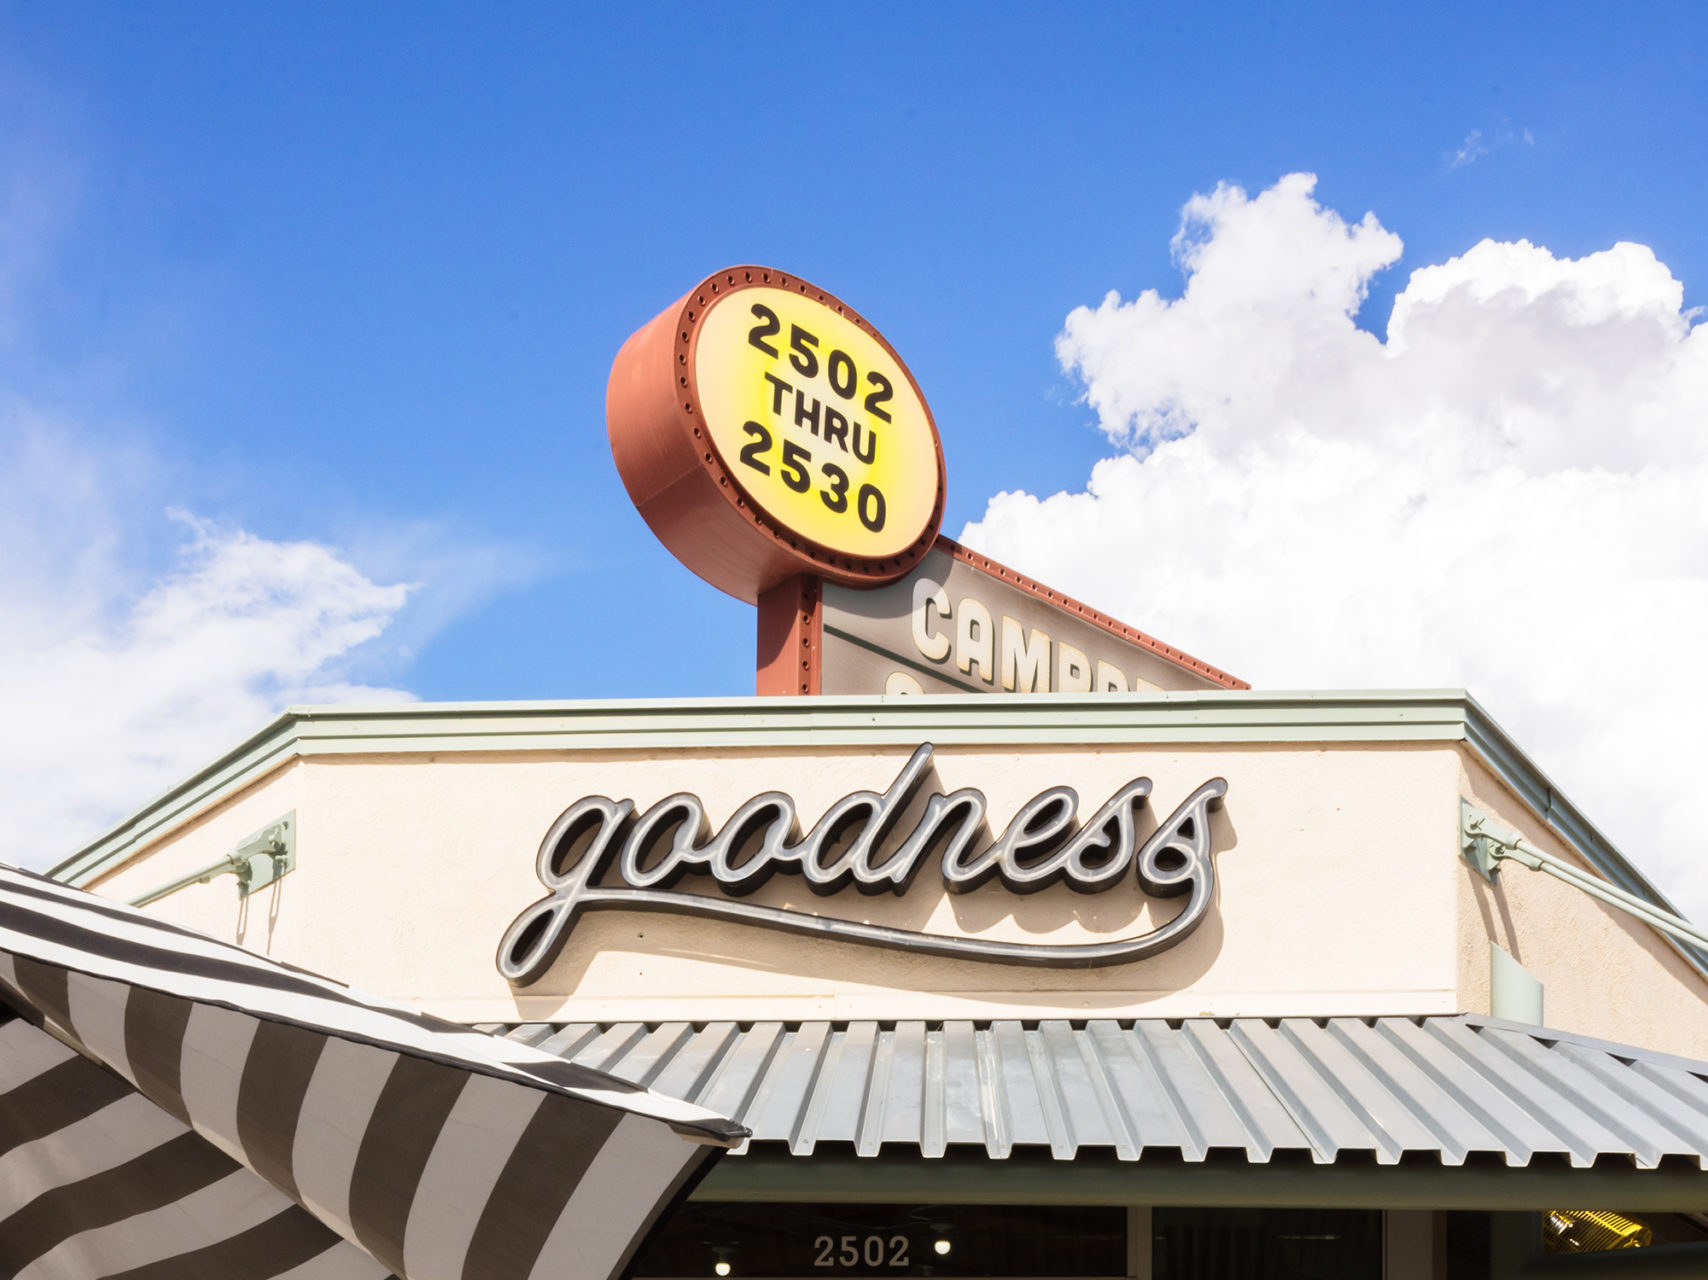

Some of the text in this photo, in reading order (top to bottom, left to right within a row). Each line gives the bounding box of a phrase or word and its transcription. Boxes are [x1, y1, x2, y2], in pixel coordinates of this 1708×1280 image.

[748, 303, 893, 424] 2502
[764, 372, 876, 465] THRU
[740, 421, 886, 533] 2530
[912, 577, 1165, 692] CAMP
[495, 742, 1228, 987] goodness
[813, 1235, 910, 1268] 2502
